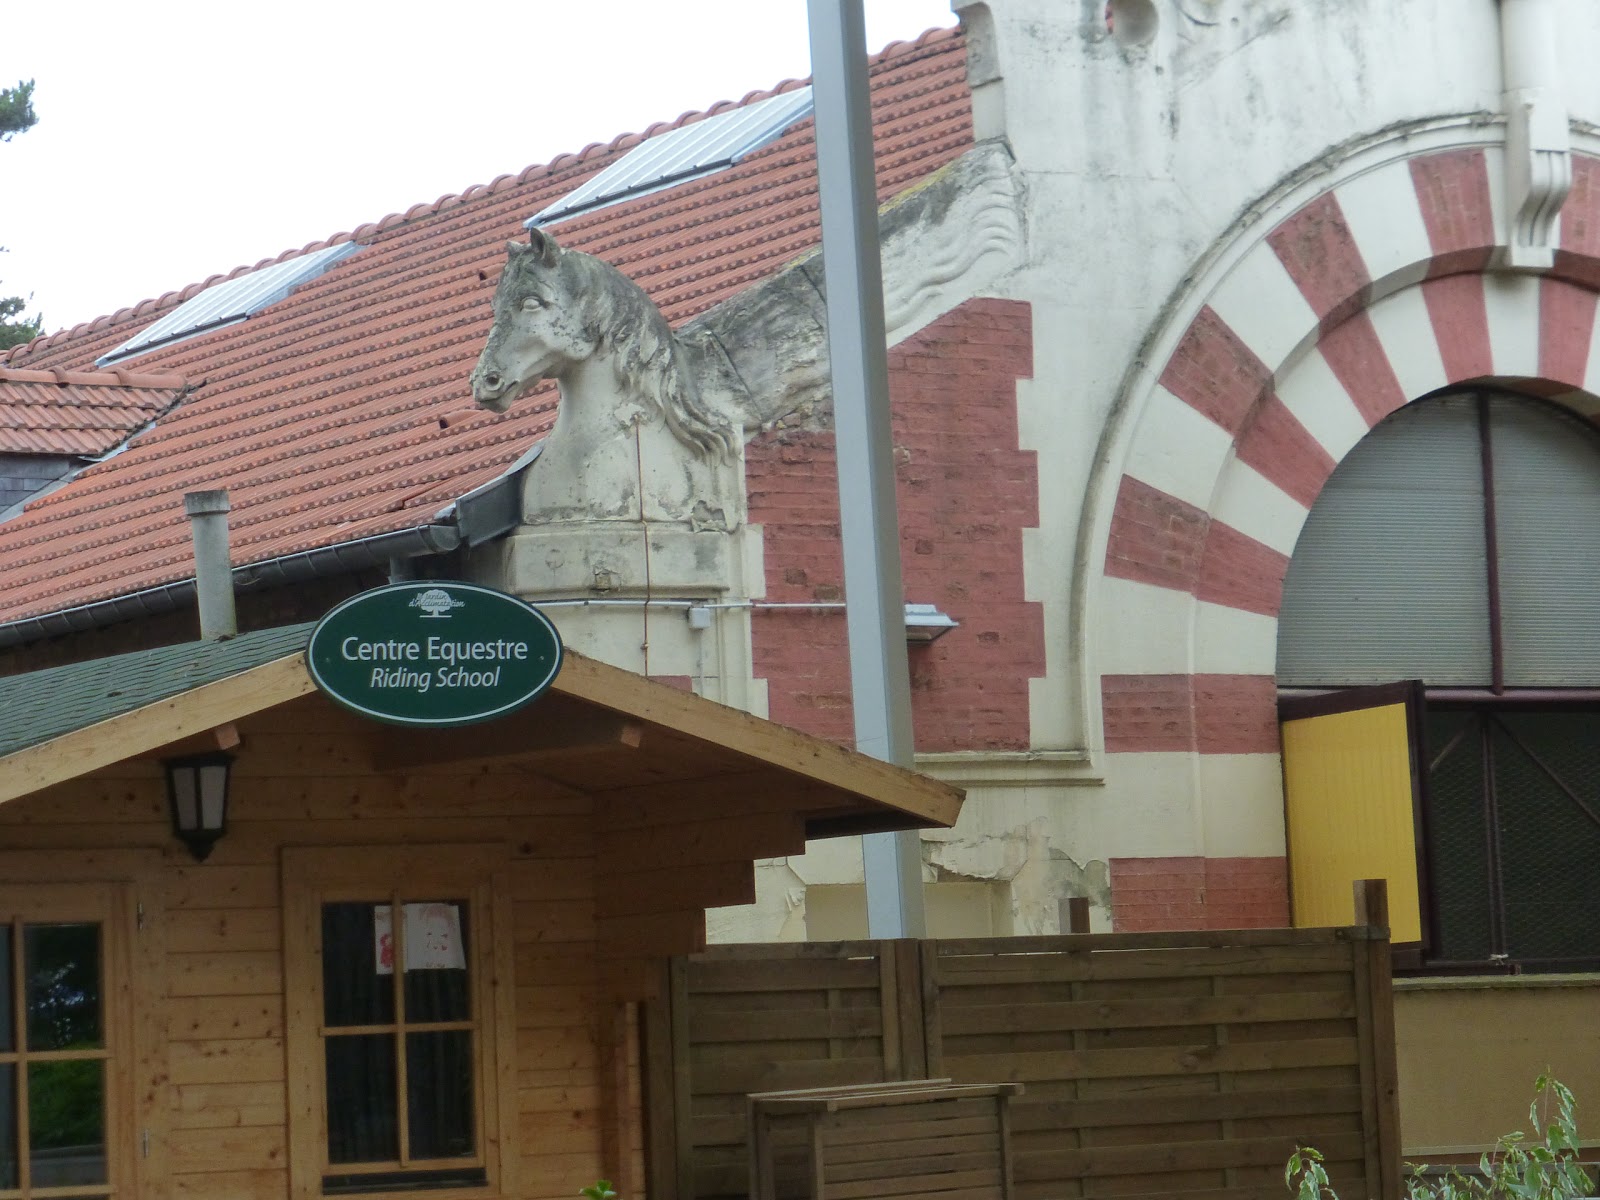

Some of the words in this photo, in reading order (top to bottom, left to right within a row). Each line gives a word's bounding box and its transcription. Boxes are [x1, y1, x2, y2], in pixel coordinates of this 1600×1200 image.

[342, 637, 420, 661] Centre
[427, 637, 528, 665] Equestre
[370, 667, 431, 693] Riding
[435, 666, 500, 687] School
